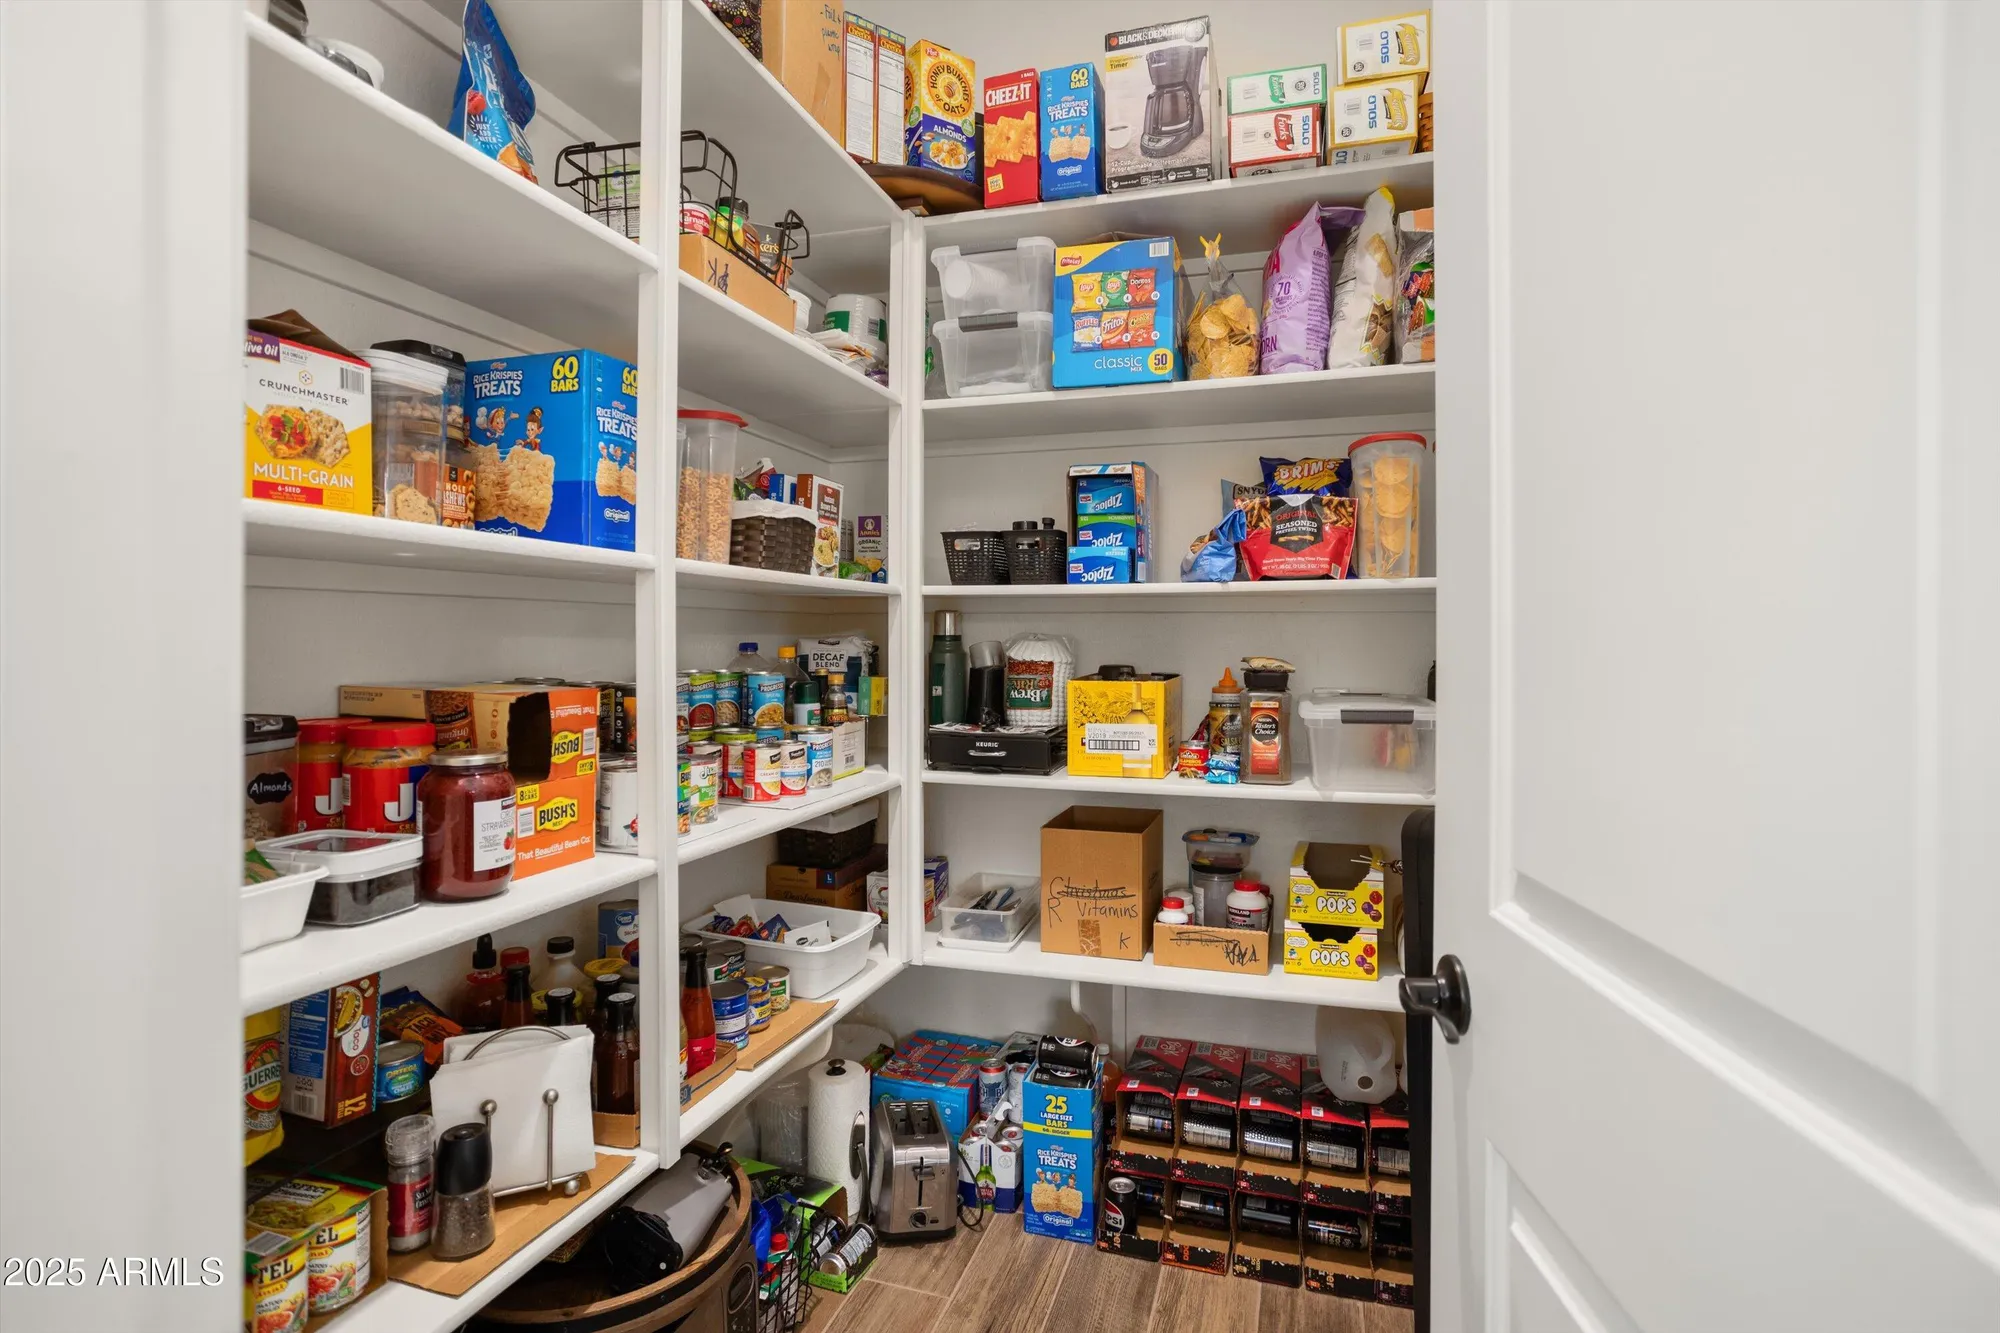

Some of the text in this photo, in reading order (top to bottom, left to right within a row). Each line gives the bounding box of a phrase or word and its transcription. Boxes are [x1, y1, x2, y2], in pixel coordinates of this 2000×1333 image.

[1380, 30, 1389, 64] SOLO
[1071, 68, 1088, 81] 60
[930, 64, 970, 104] HONEY BUNCHES
[1070, 80, 1088, 89] BARS
[943, 102, 966, 114] OATS
[1049, 107, 1088, 122] TREATS
[1368, 95, 1377, 128] SOLO
[933, 125, 967, 142] ALMONDS
[1278, 116, 1289, 140] Forks
[760, 242, 779, 254] ker's
[1277, 282, 1290, 296] 70
[244, 341, 278, 356] live Oil
[1094, 354, 1143, 369] classic
[1154, 353, 1168, 366] 50
[552, 356, 579, 380] 60
[473, 370, 523, 384] RICE KRISPIES
[259, 378, 348, 406] CRUNCHMASTER
[474, 380, 521, 399] TREATS
[551, 378, 579, 393] BARS
[596, 407, 611, 417] RICE
[598, 416, 638, 440] TREATS
[254, 462, 353, 488] MULTI-GRAIN
[1280, 461, 1336, 480] BRIM'S
[444, 482, 466, 493] HOLE
[444, 491, 466, 506] SHEWS
[1095, 492, 1123, 511] Ziploc
[1276, 511, 1318, 520] ORIGINAL
[1276, 520, 1318, 530] SEASONED
[1091, 532, 1123, 548] Ziploc
[1081, 565, 1114, 582] Ziploc
[812, 653, 844, 661] DECAF
[1010, 688, 1041, 702] Brew
[812, 738, 833, 750] PROGRESS
[250, 782, 292, 795] Almonds
[520, 791, 524, 801] 8
[540, 803, 576, 826] BUSH'S
[518, 851, 534, 861] That
[535, 842, 564, 857] Beautiful
[565, 840, 580, 849] Bean
[1316, 896, 1356, 914] POPS
[1048, 898, 1138, 928] R Vitamins
[1310, 948, 1350, 966] POPS
[386, 1064, 418, 1078] ORTEGA
[345, 1093, 367, 1117] 12
[1045, 1094, 1067, 1114] 25
[1040, 1112, 1059, 1120] LARGE
[1046, 1119, 1068, 1128] BARS
[1050, 1150, 1077, 1160] KRISPIES
[1038, 1156, 1076, 1170] TREATS
[1044, 1215, 1072, 1225] Original
